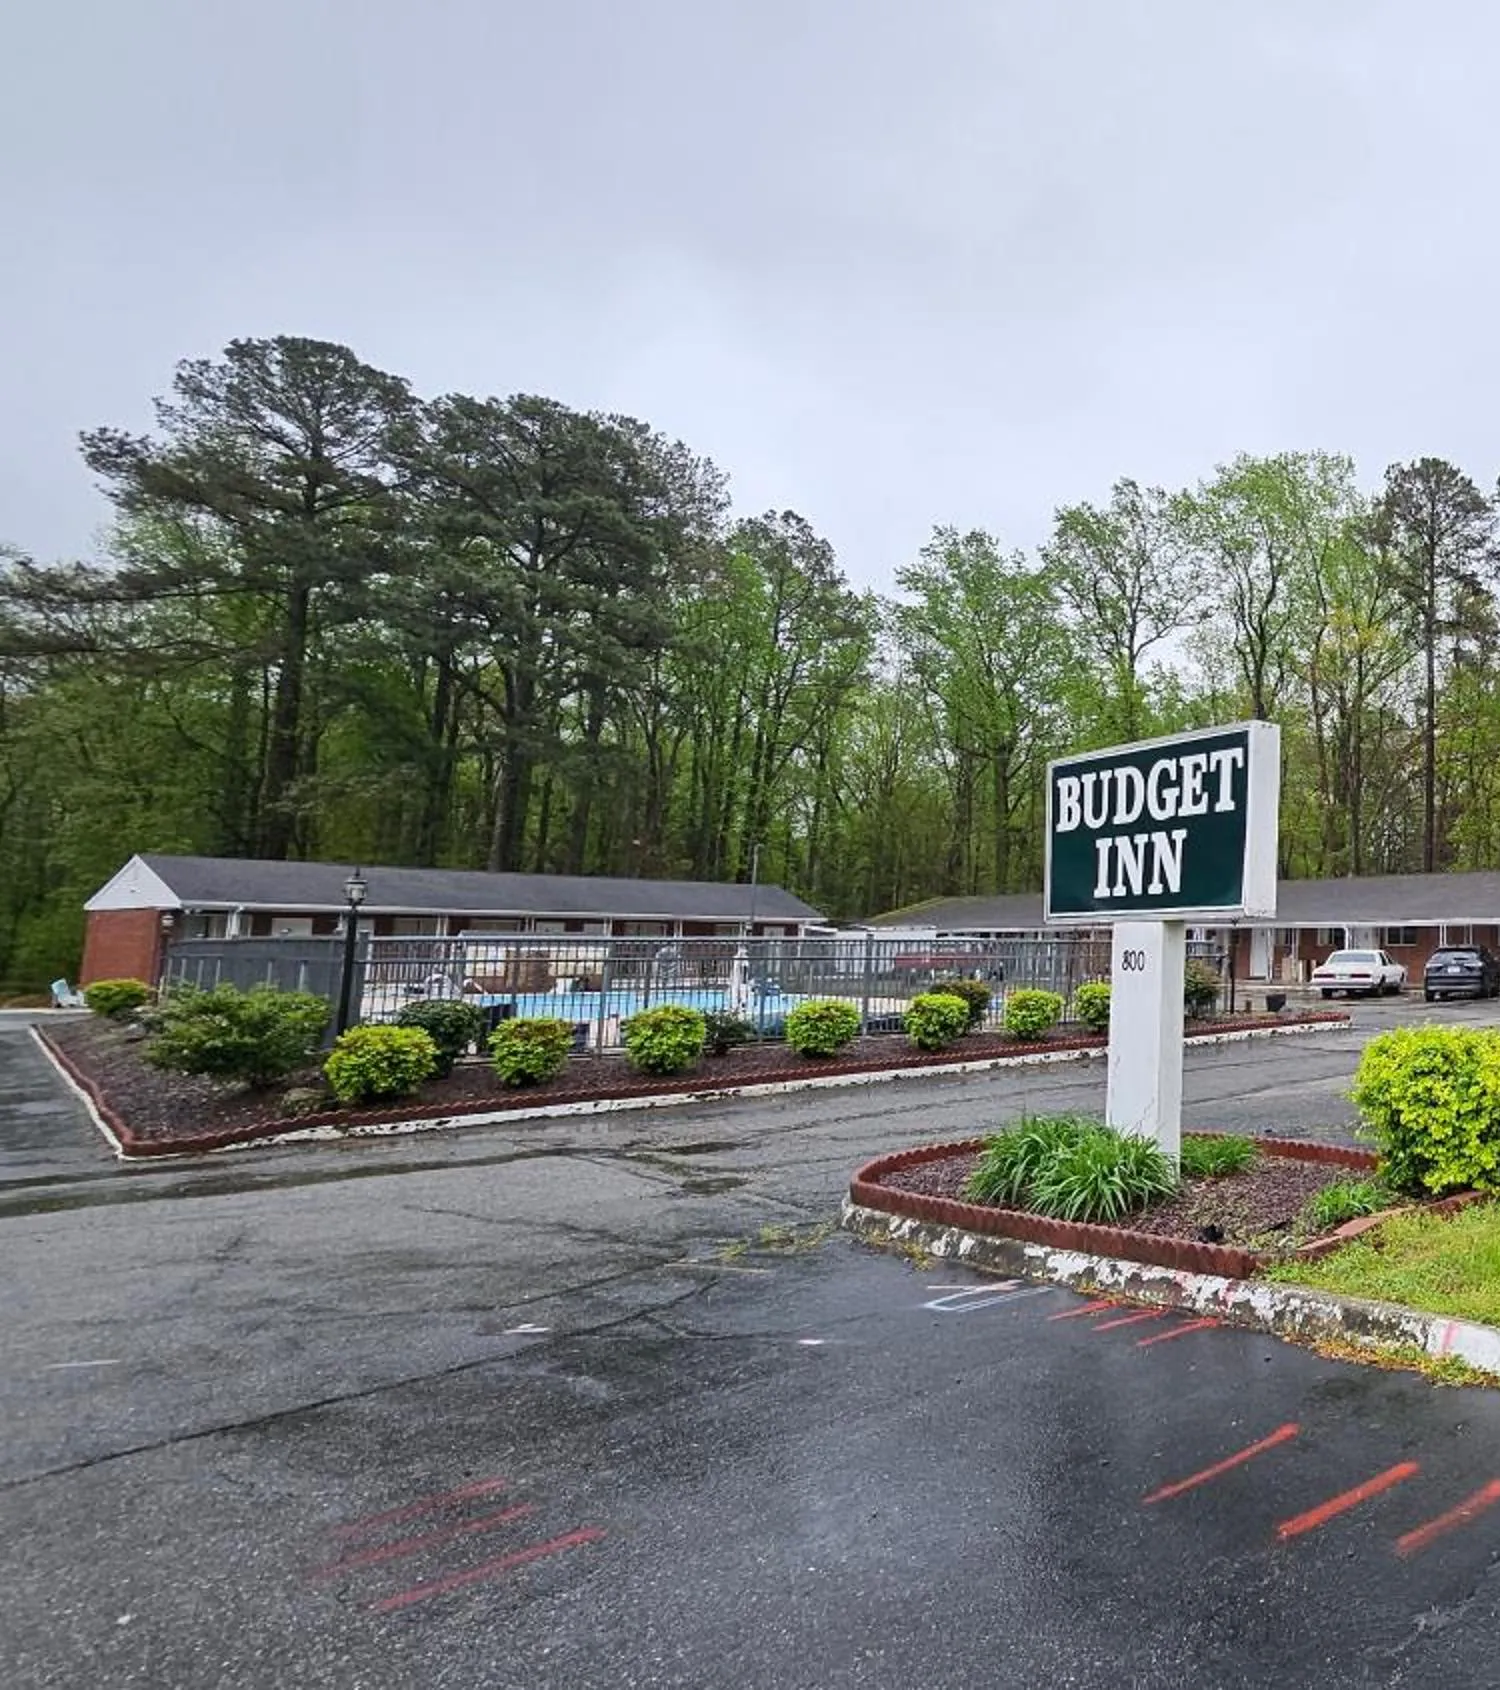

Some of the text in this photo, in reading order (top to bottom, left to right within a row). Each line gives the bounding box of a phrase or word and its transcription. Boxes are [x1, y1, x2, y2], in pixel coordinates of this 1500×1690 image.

[1055, 747, 1244, 833] BUDGET
[1093, 828, 1188, 899] INN
[1121, 949, 1145, 971] 800
